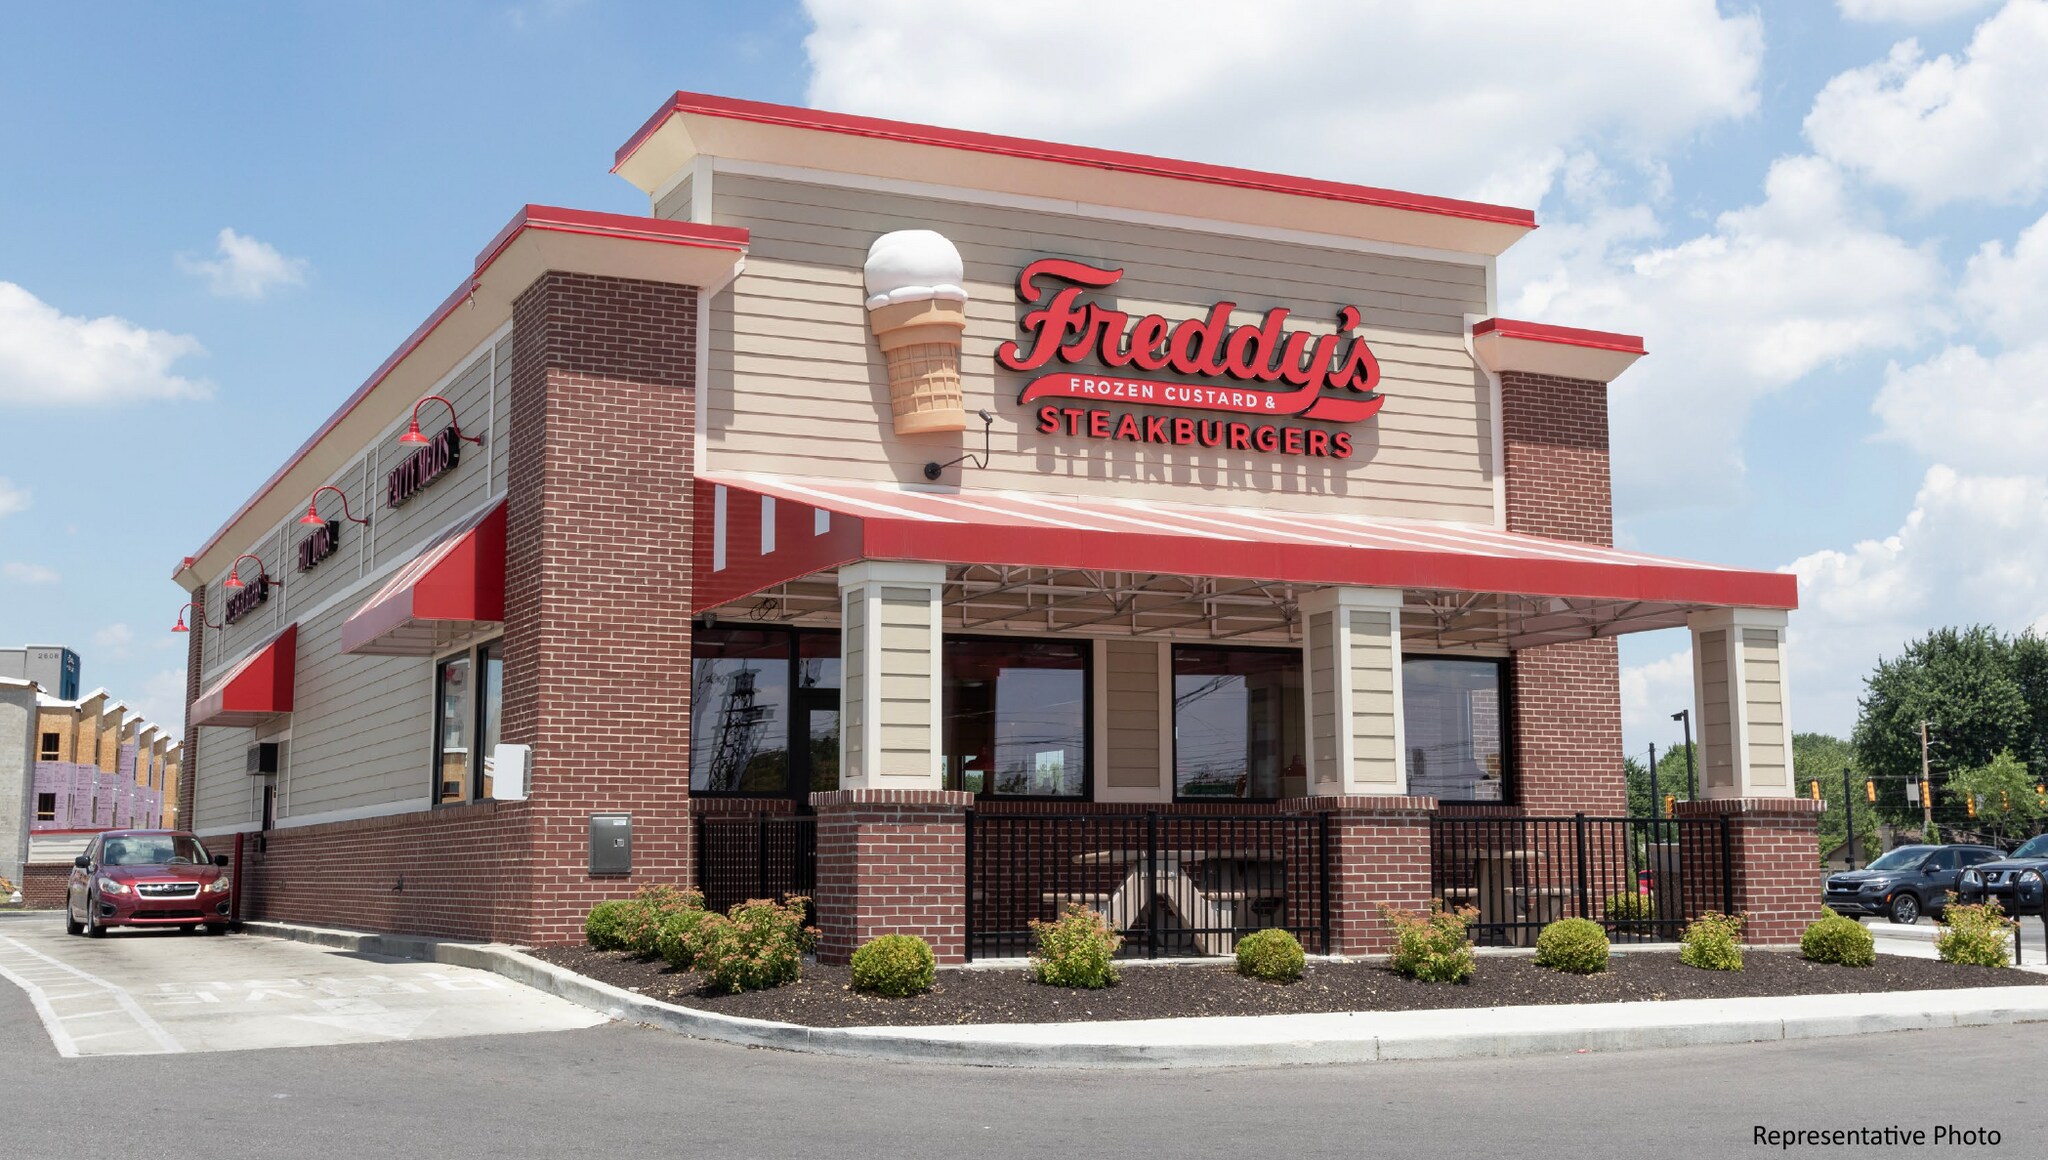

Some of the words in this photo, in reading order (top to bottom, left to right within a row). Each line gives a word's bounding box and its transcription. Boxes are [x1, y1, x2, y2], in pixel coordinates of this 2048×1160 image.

[994, 257, 1384, 402] Freddy's
[1069, 377, 1154, 400] FROZEN
[1164, 386, 1259, 409] CUSTARD
[1264, 395, 1277, 410] &
[1036, 404, 1355, 459] STEAKBURGERS
[386, 451, 416, 509] PATTY
